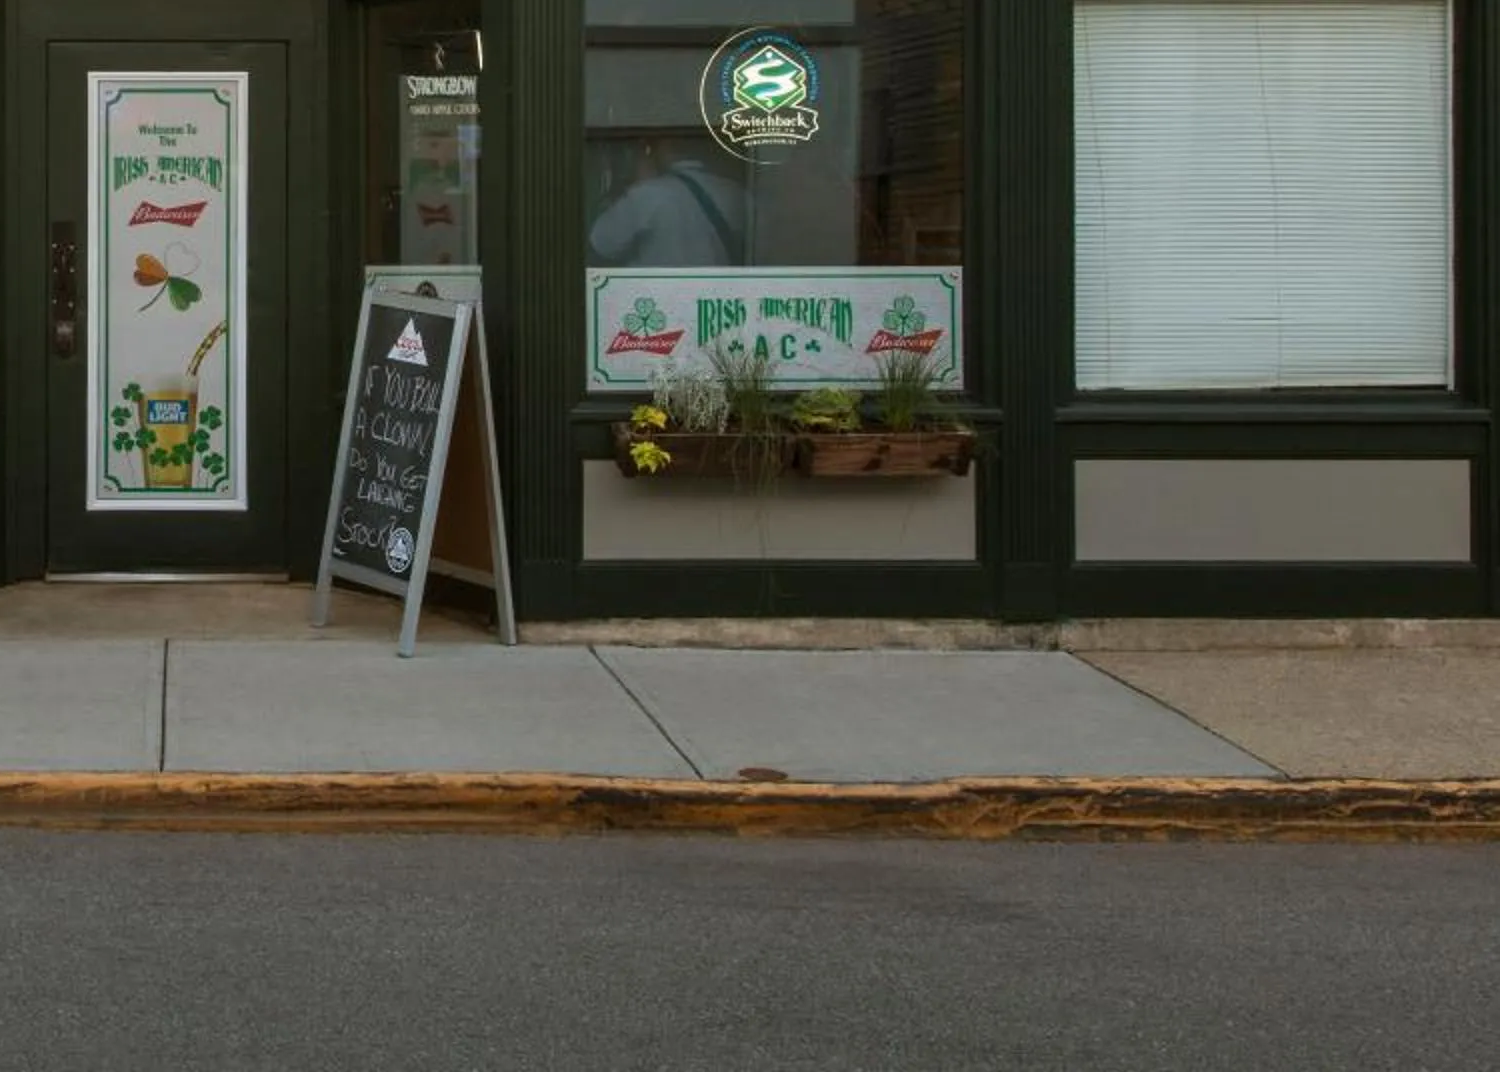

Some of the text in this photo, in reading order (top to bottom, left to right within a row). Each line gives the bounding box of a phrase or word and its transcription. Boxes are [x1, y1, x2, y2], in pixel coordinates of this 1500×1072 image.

[407, 75, 478, 99] STRONGBOW
[139, 124, 184, 135] Welcome
[731, 112, 810, 129] Switchback
[114, 156, 222, 192] IRISH AMERICAN
[697, 298, 853, 347] IRISH AMERICAN
[613, 335, 677, 351] Budweiser
[384, 365, 410, 409] YOU
[355, 406, 367, 440] A
